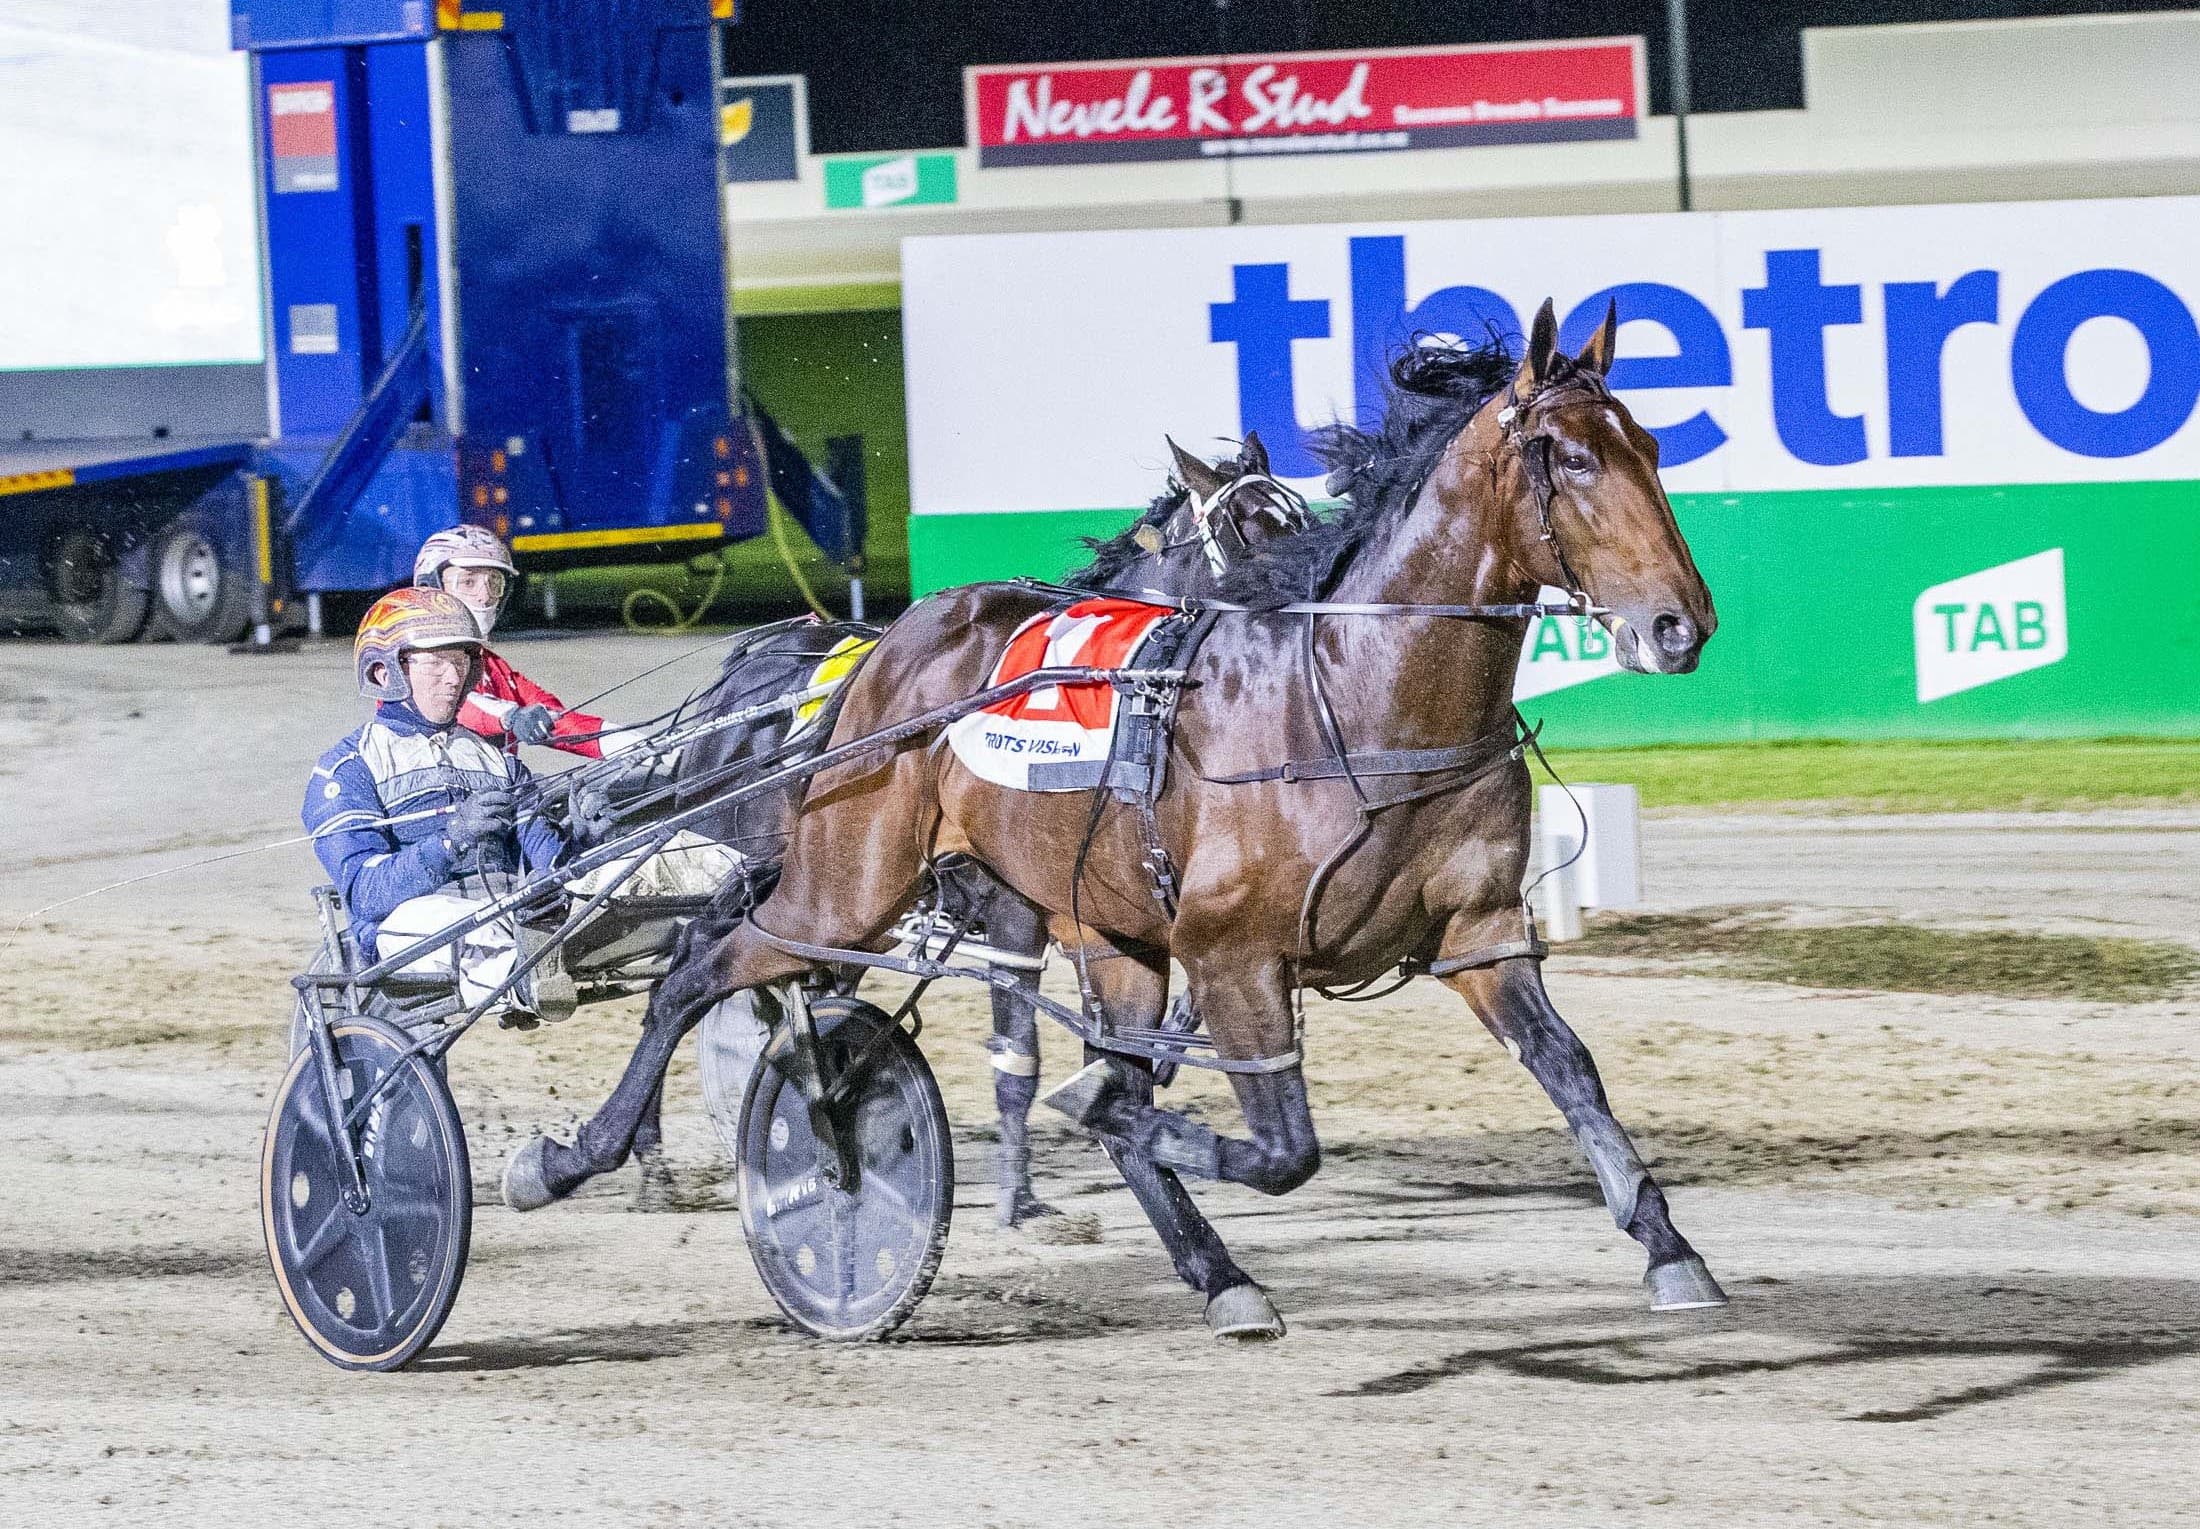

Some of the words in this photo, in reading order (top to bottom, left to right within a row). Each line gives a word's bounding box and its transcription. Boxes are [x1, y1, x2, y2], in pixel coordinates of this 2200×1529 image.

[1004, 70, 1177, 143] Nevele
[1187, 68, 1232, 132] R
[1241, 62, 1372, 132] Stud
[1531, 614, 1609, 662] AB
[1933, 601, 2047, 652] TAB
